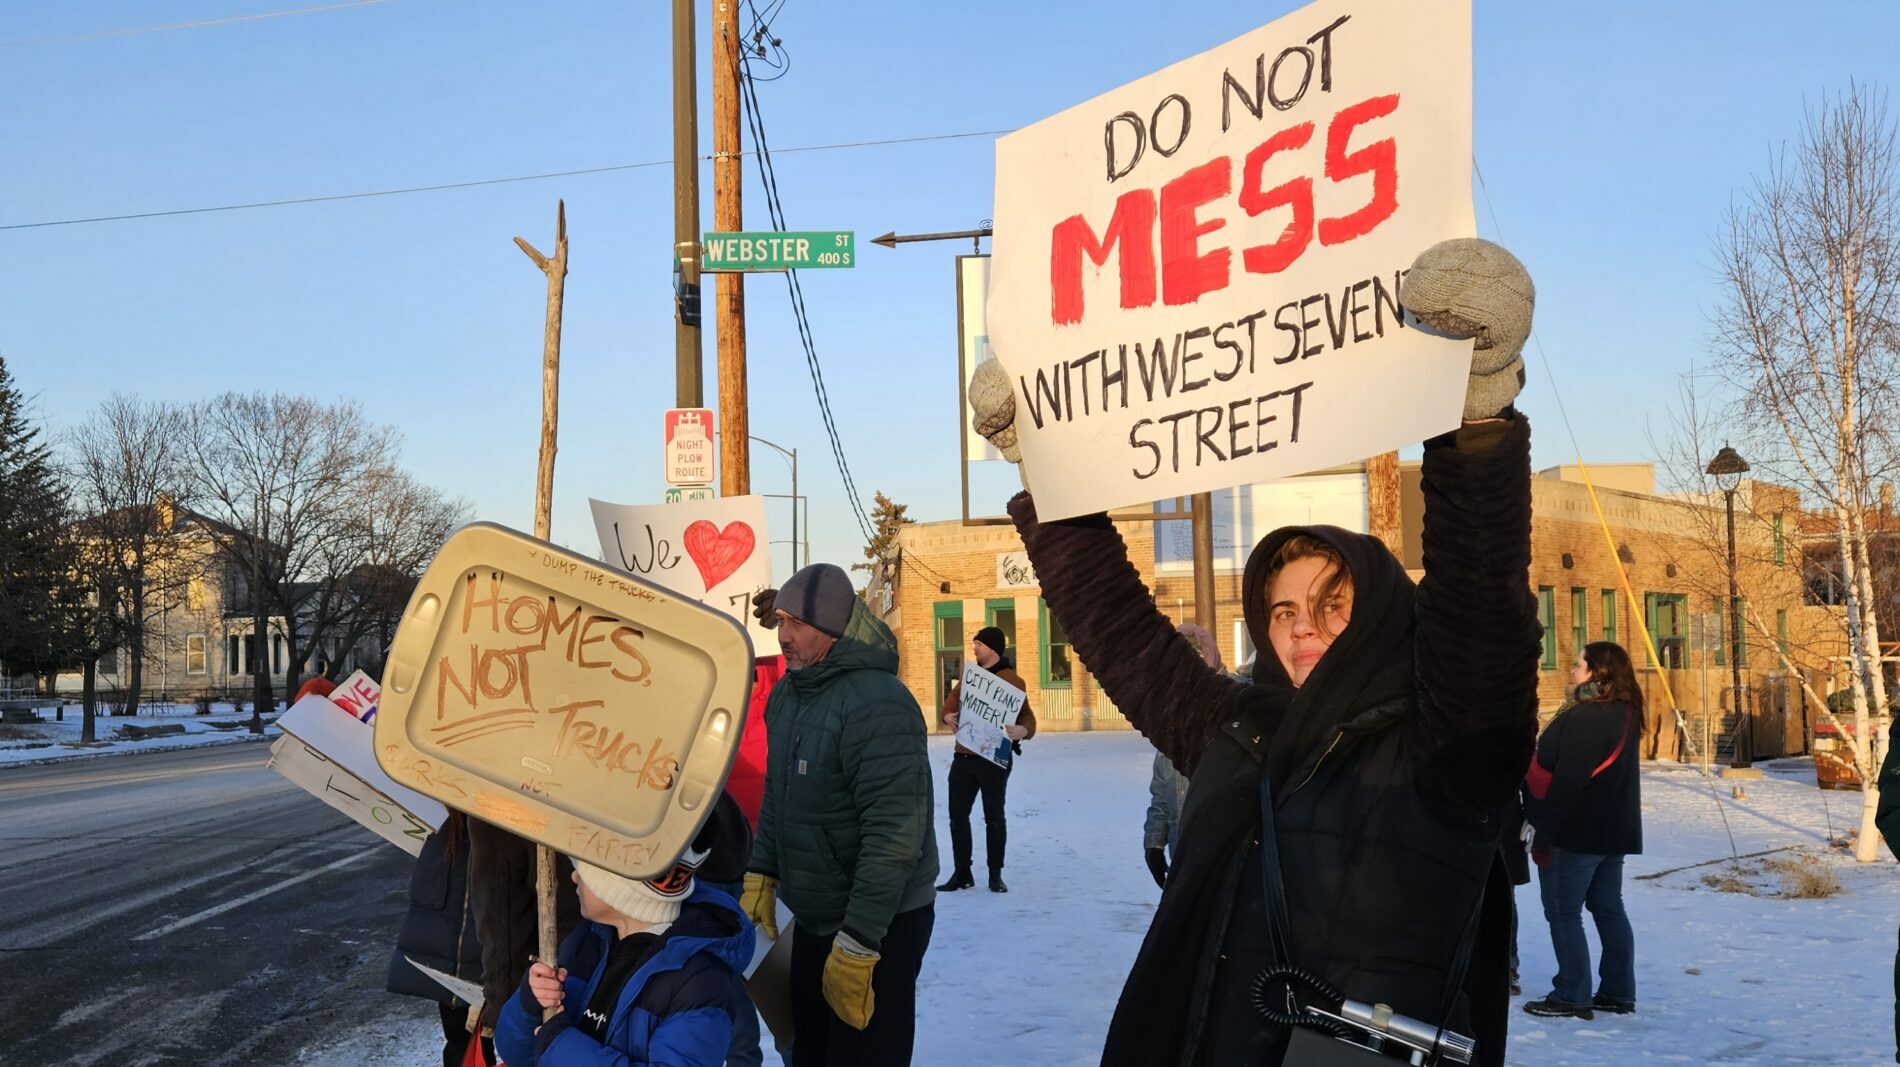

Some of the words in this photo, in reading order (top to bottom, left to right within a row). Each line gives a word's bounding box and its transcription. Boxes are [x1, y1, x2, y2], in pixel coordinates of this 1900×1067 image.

[1105, 94, 1191, 184] DO
[1222, 15, 1351, 133] NOT
[1051, 93, 1400, 327] MESS
[707, 239, 810, 261] WEBSTER
[835, 235, 849, 246] ST
[817, 253, 840, 264] 400
[842, 253, 850, 264] S
[1020, 343, 1128, 430] WITH
[1135, 310, 1267, 402] WEST
[1272, 269, 1421, 366] SEVEN
[676, 440, 704, 450] NIGHT
[1128, 382, 1313, 479] STREET
[675, 467, 705, 477] ROUTE
[677, 454, 703, 463] PLOW
[689, 491, 705, 500] MIN
[613, 522, 682, 573] We
[543, 554, 577, 576] DUMP
[583, 571, 604, 586] THE
[609, 580, 656, 602] TRUCKS
[436, 643, 546, 721] NOT
[965, 669, 995, 694] CITY
[992, 686, 1020, 713] PLANS
[962, 690, 1007, 730] MATTER!
